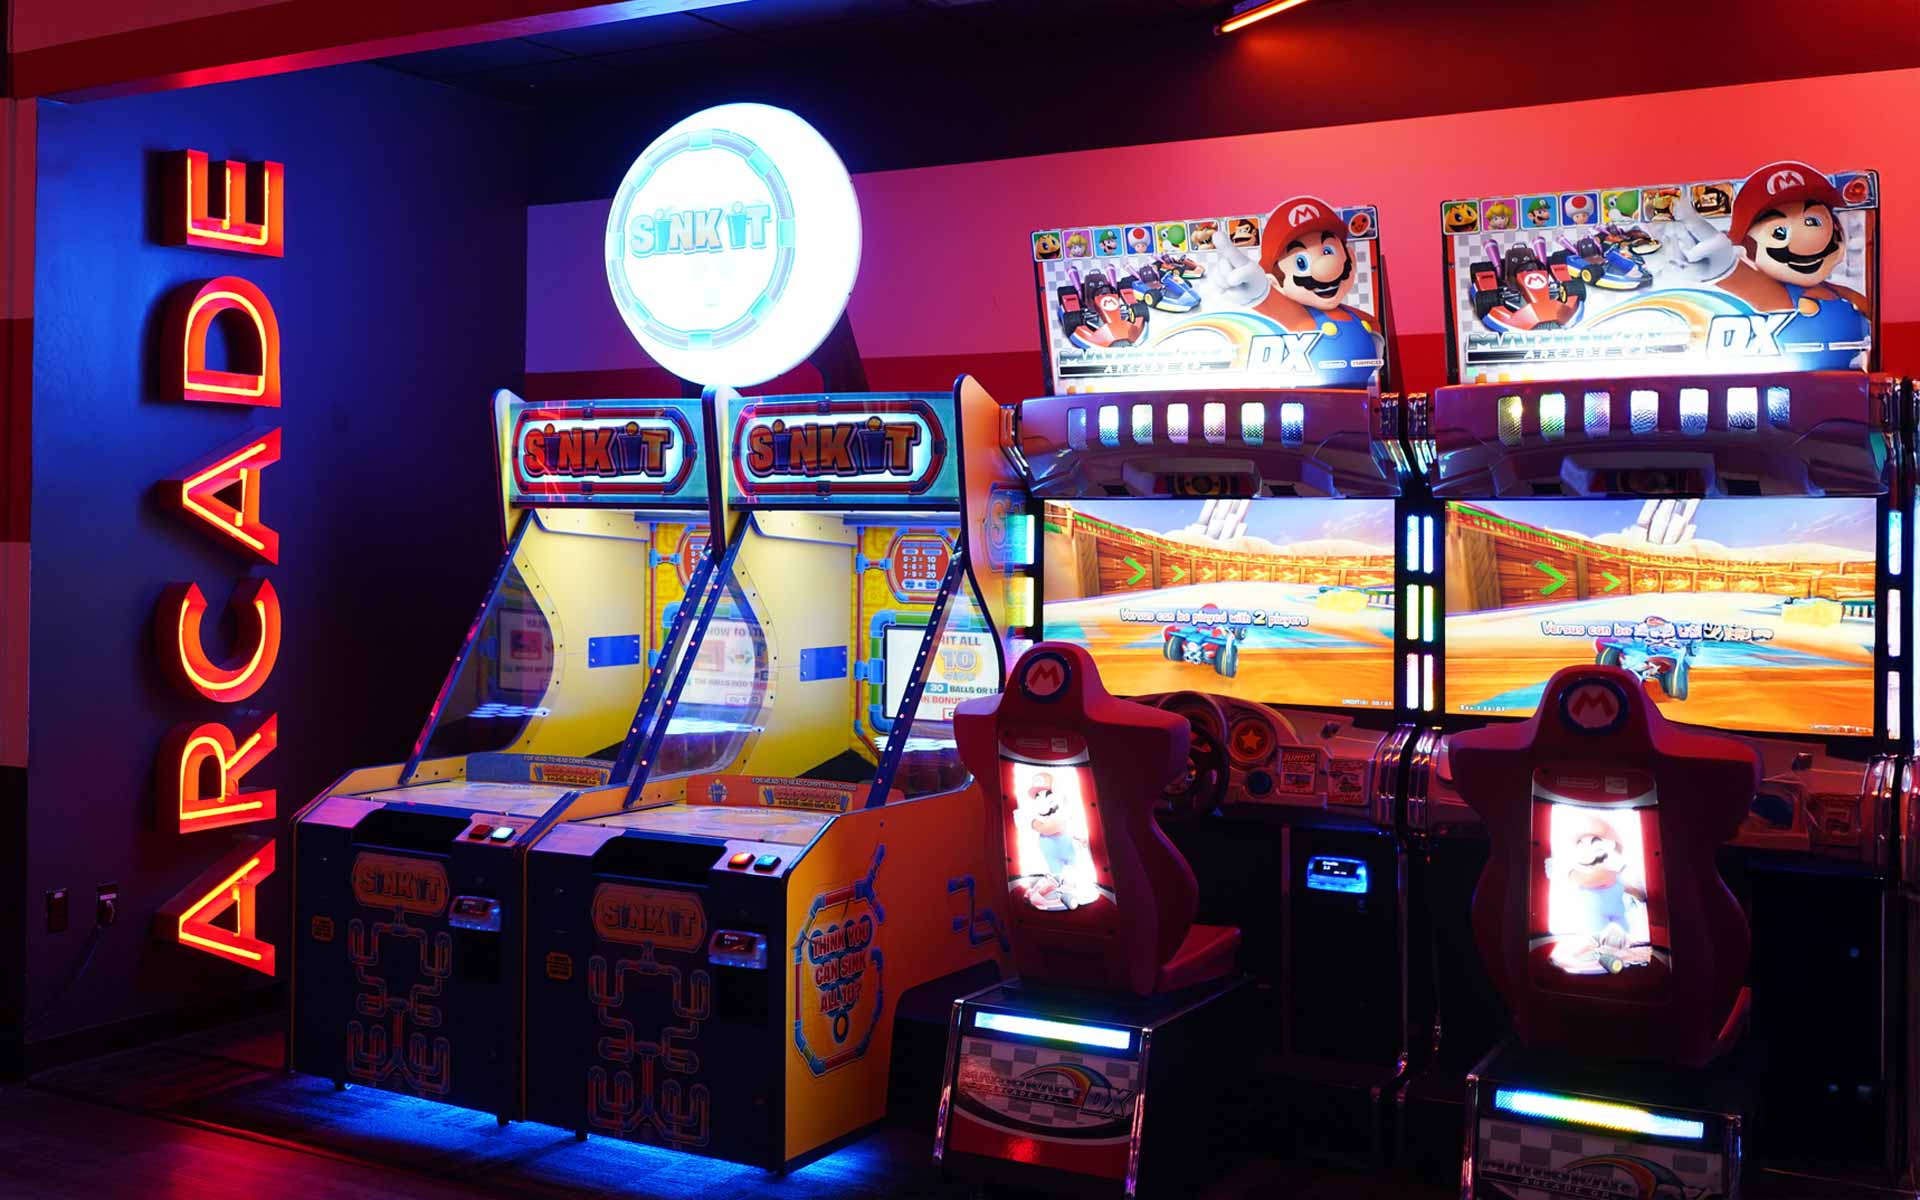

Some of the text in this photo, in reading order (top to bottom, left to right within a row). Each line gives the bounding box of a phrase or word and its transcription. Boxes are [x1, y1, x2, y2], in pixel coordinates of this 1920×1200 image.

[1706, 311, 1795, 358] DX
[1248, 331, 1320, 375] DX
[166, 148, 286, 978] ARCADE
[1120, 608, 1310, 628] Versus can be played with 2 players
[1541, 620, 1586, 636] Versus
[1587, 623, 1612, 636] can
[960, 636, 982, 646] ALL
[941, 648, 977, 671] 10
[949, 685, 975, 694] BALLS
[813, 921, 869, 959] THINK YOU
[815, 950, 867, 985] CAN SINK
[821, 988, 840, 1012] ALL
[1080, 1083, 1134, 1120] DX
